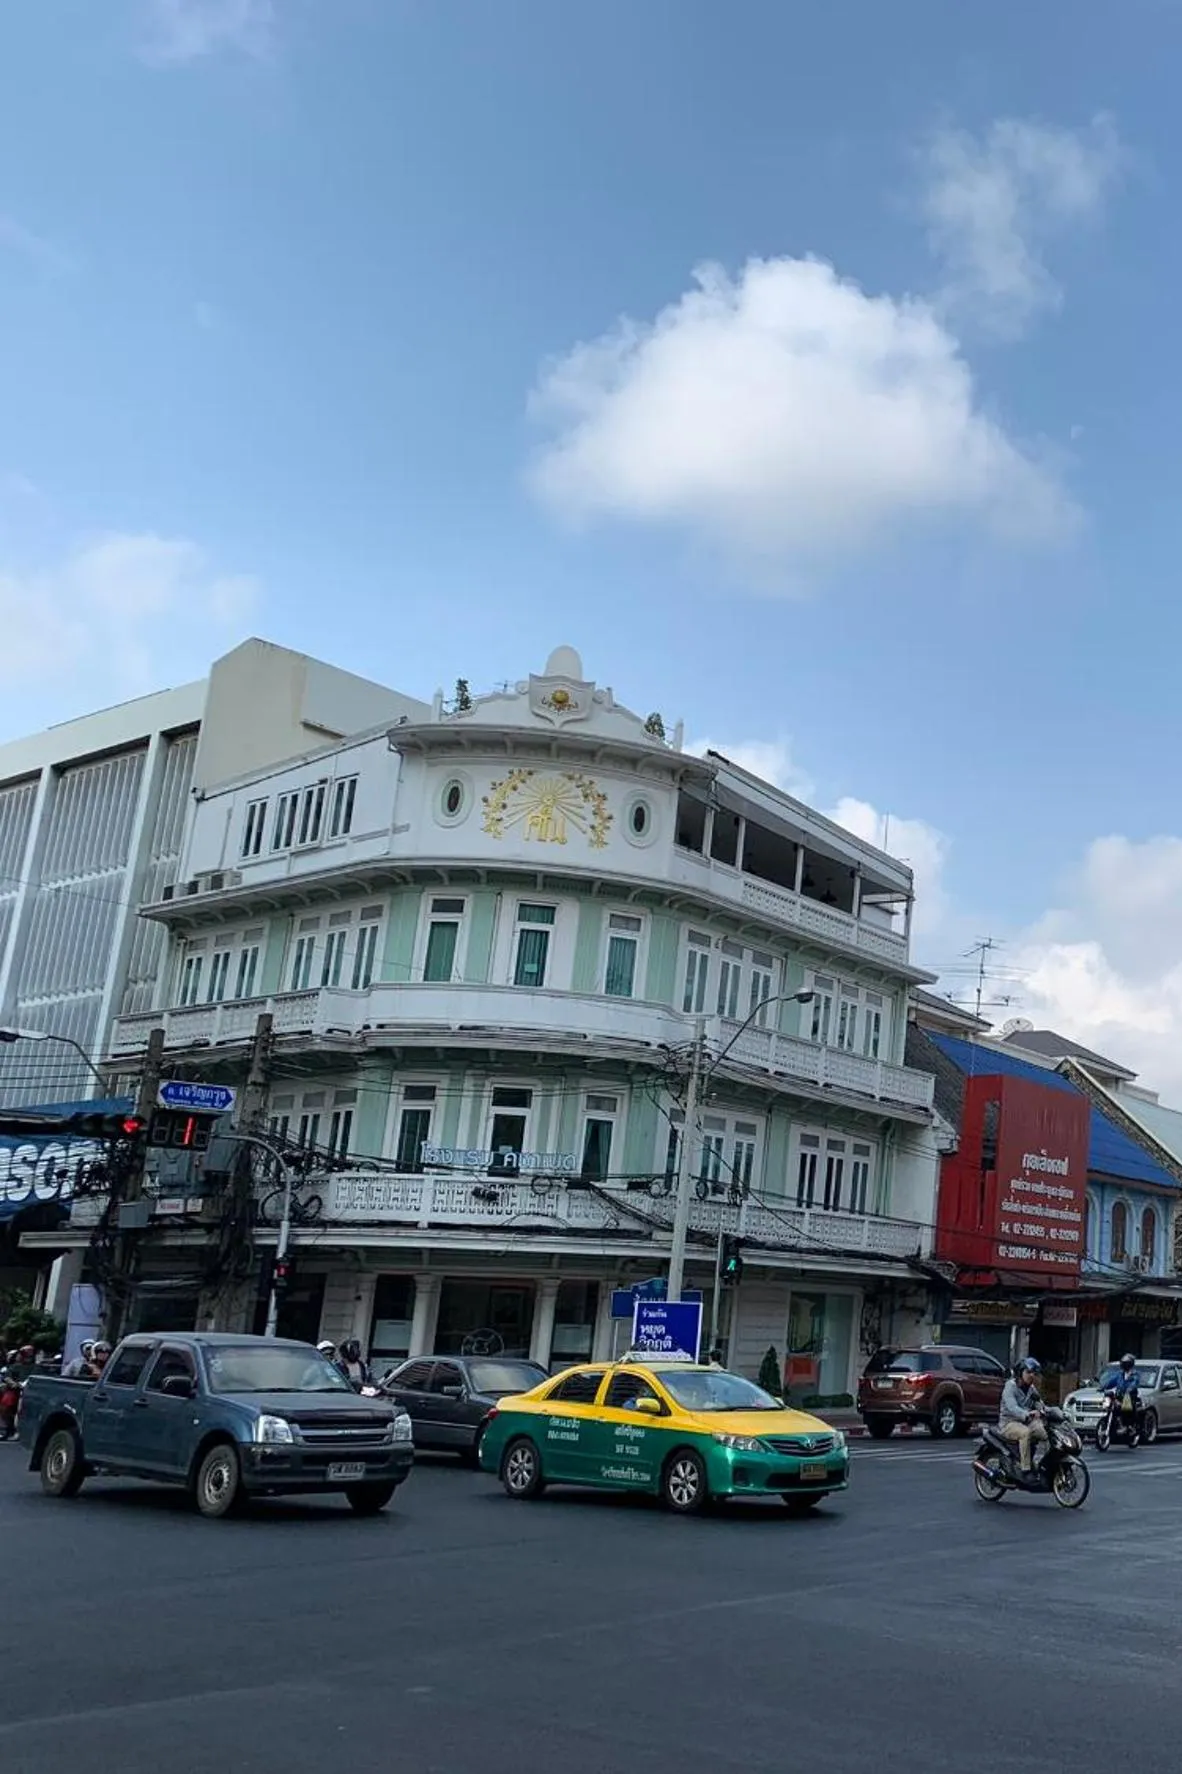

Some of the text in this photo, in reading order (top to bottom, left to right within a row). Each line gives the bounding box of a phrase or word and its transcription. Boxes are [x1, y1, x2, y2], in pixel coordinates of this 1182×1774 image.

[642, 1307, 668, 1319] ร่วมกัน
[640, 1325, 666, 1339] หยุด
